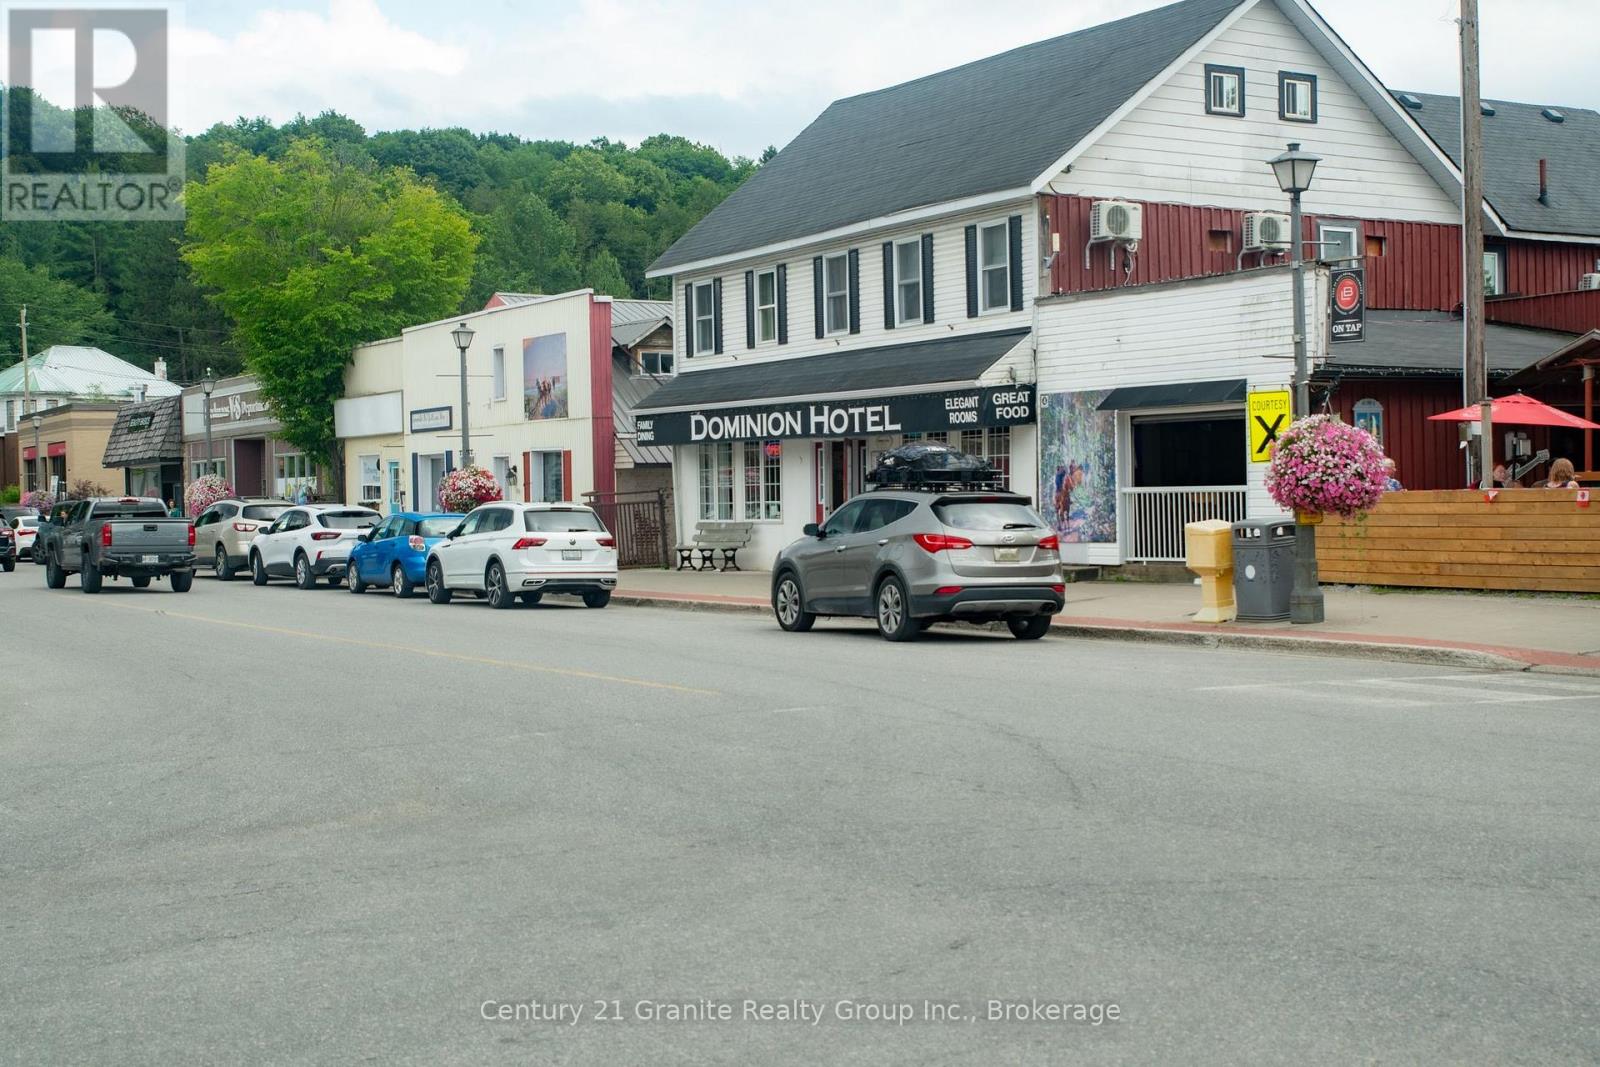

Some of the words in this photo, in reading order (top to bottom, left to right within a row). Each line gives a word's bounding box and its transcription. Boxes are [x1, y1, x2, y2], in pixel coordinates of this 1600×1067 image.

[1332, 325, 1344, 333] ON
[1345, 323, 1362, 332] TAP
[945, 396, 979, 410] ELEGANT
[992, 391, 1030, 405] GREAT
[1252, 400, 1287, 411] COURTESY
[949, 411, 978, 424] ROOMS
[995, 406, 1029, 419] FOOD
[637, 420, 654, 430] FAMILY
[690, 411, 802, 441] DOMINION
[809, 405, 901, 434] HOTEL
[637, 431, 655, 441] DINING
